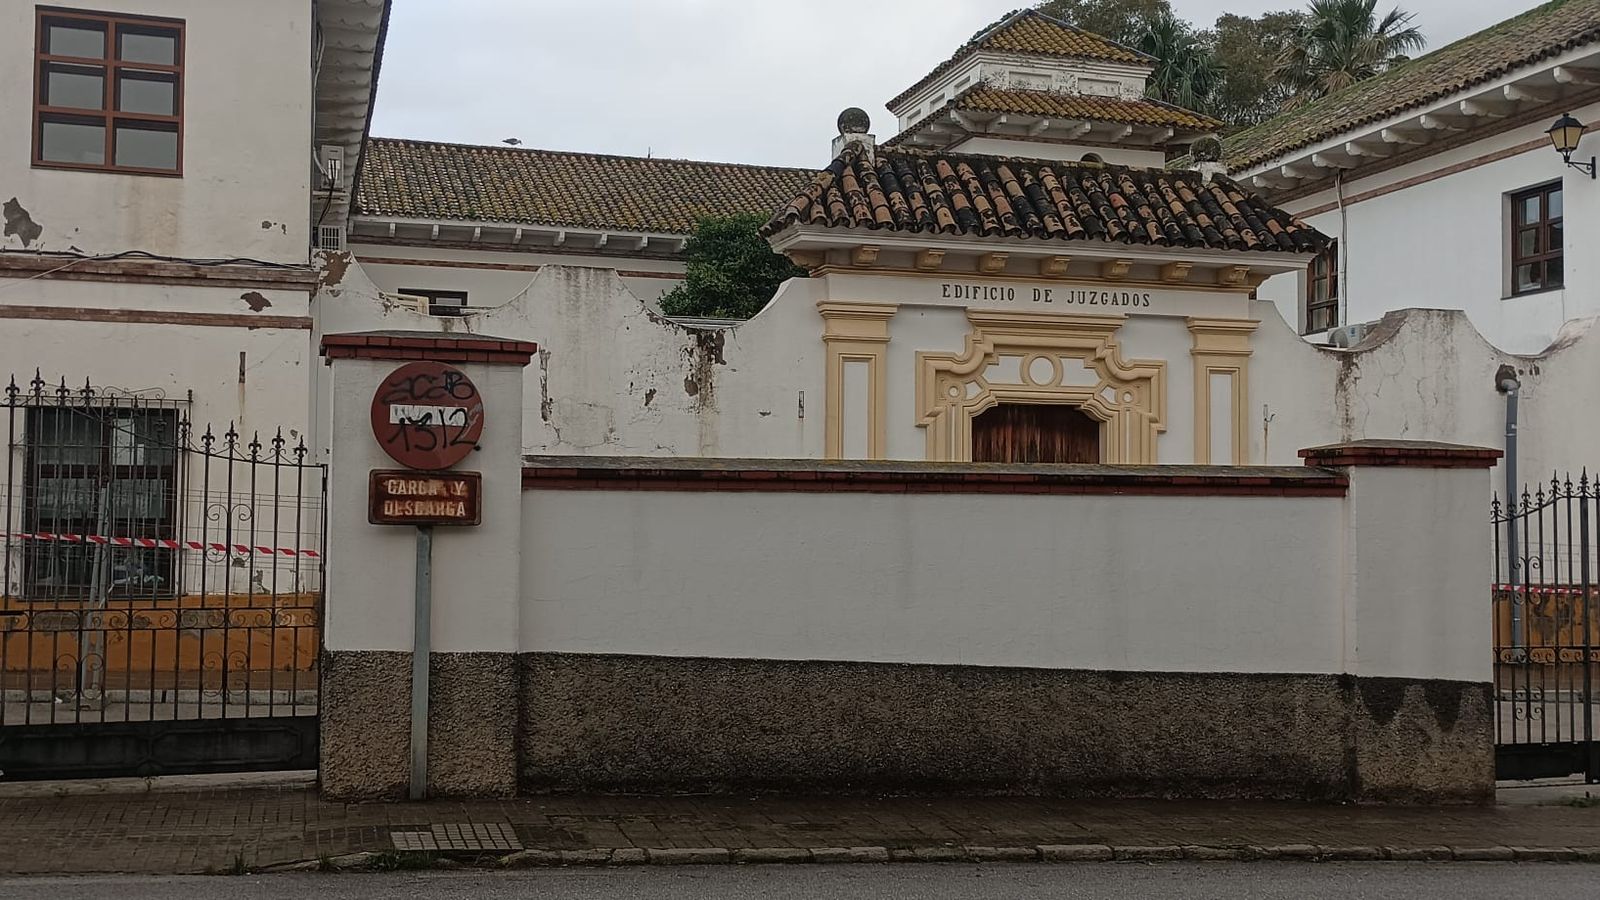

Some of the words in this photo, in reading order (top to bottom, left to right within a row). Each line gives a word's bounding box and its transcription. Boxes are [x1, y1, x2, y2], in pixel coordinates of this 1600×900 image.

[942, 284, 1015, 301] EDIFICIO
[1033, 288, 1053, 303] DE
[1067, 291, 1150, 307] JUZGADOS
[454, 481, 465, 496] Y
